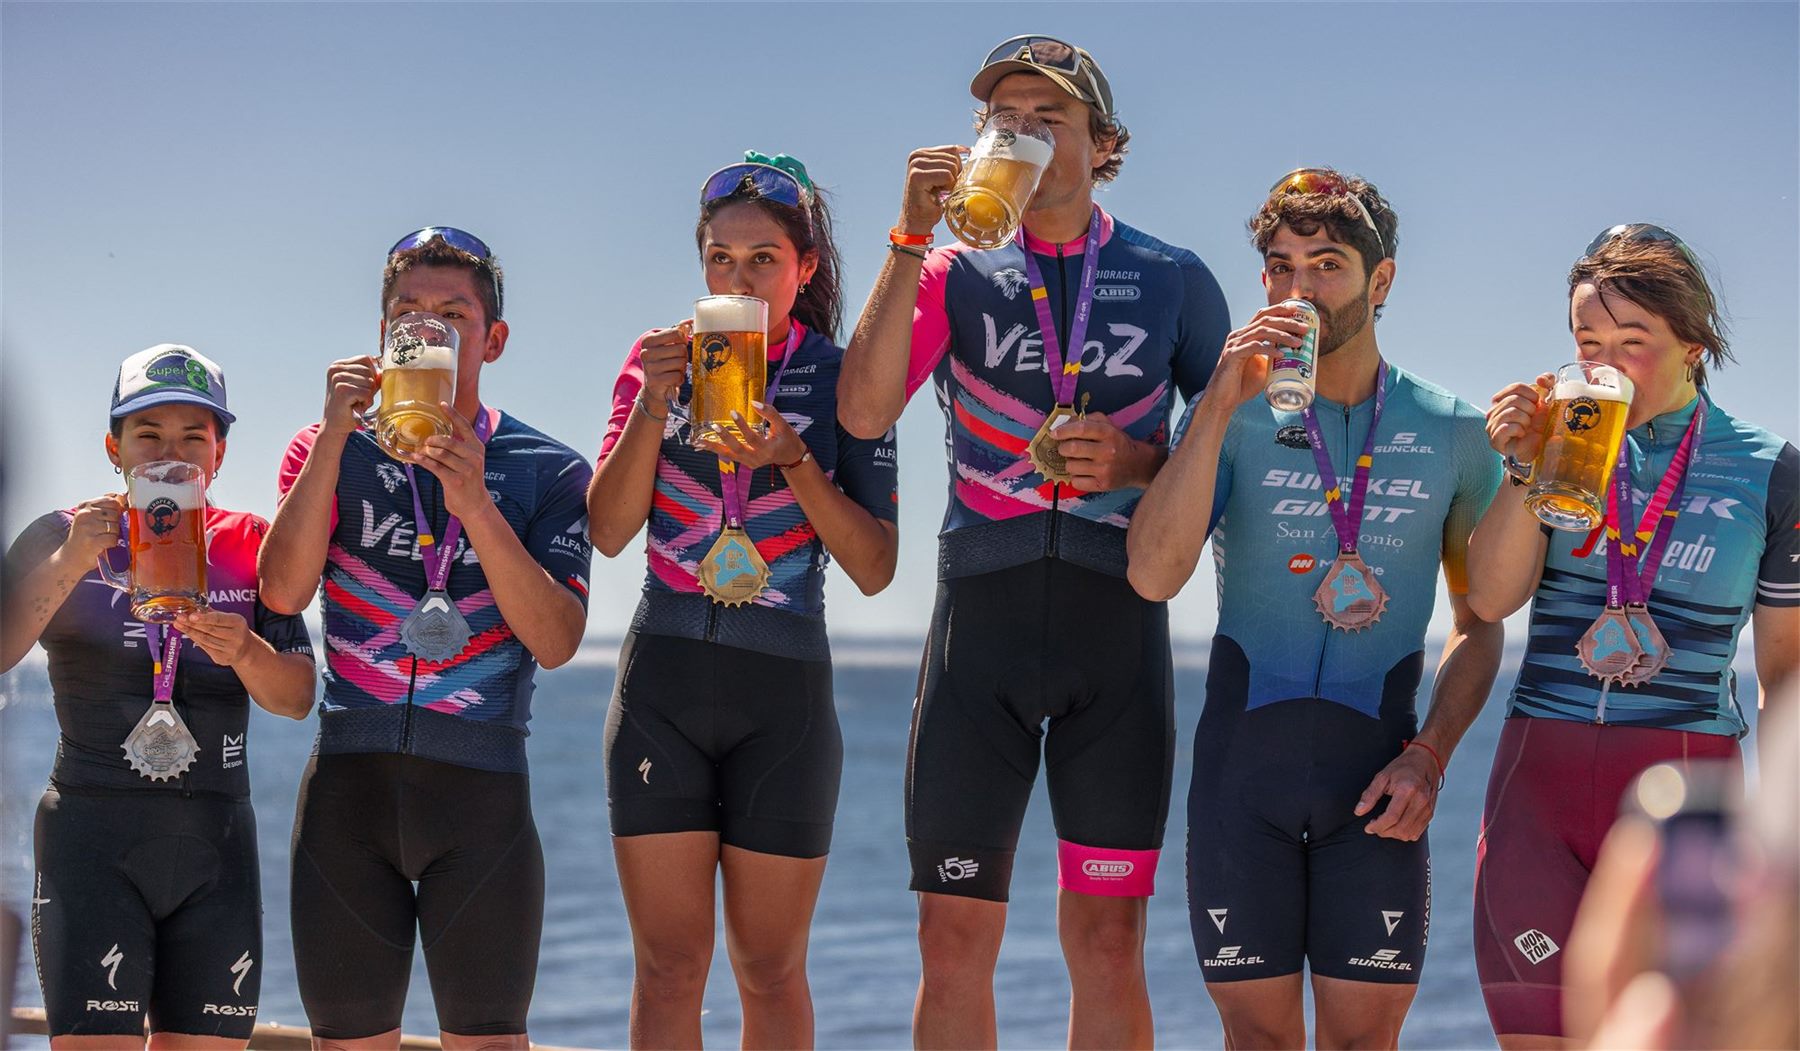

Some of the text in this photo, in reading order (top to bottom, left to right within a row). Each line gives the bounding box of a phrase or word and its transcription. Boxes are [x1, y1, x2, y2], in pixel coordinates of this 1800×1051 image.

[147, 359, 208, 391] Super 8
[1271, 499, 1416, 523] GINT
[551, 535, 582, 553] ALFA
[1276, 522, 1404, 548] San Aonio
[223, 760, 243, 769] DESIGN
[937, 865, 948, 883] HIGH
[1422, 857, 1432, 946] PATAGONIA
[1520, 930, 1544, 950] MON
[1204, 955, 1264, 967] SUNCKEL
[1526, 942, 1551, 963] TON
[1348, 957, 1412, 971] SUNCKEL
